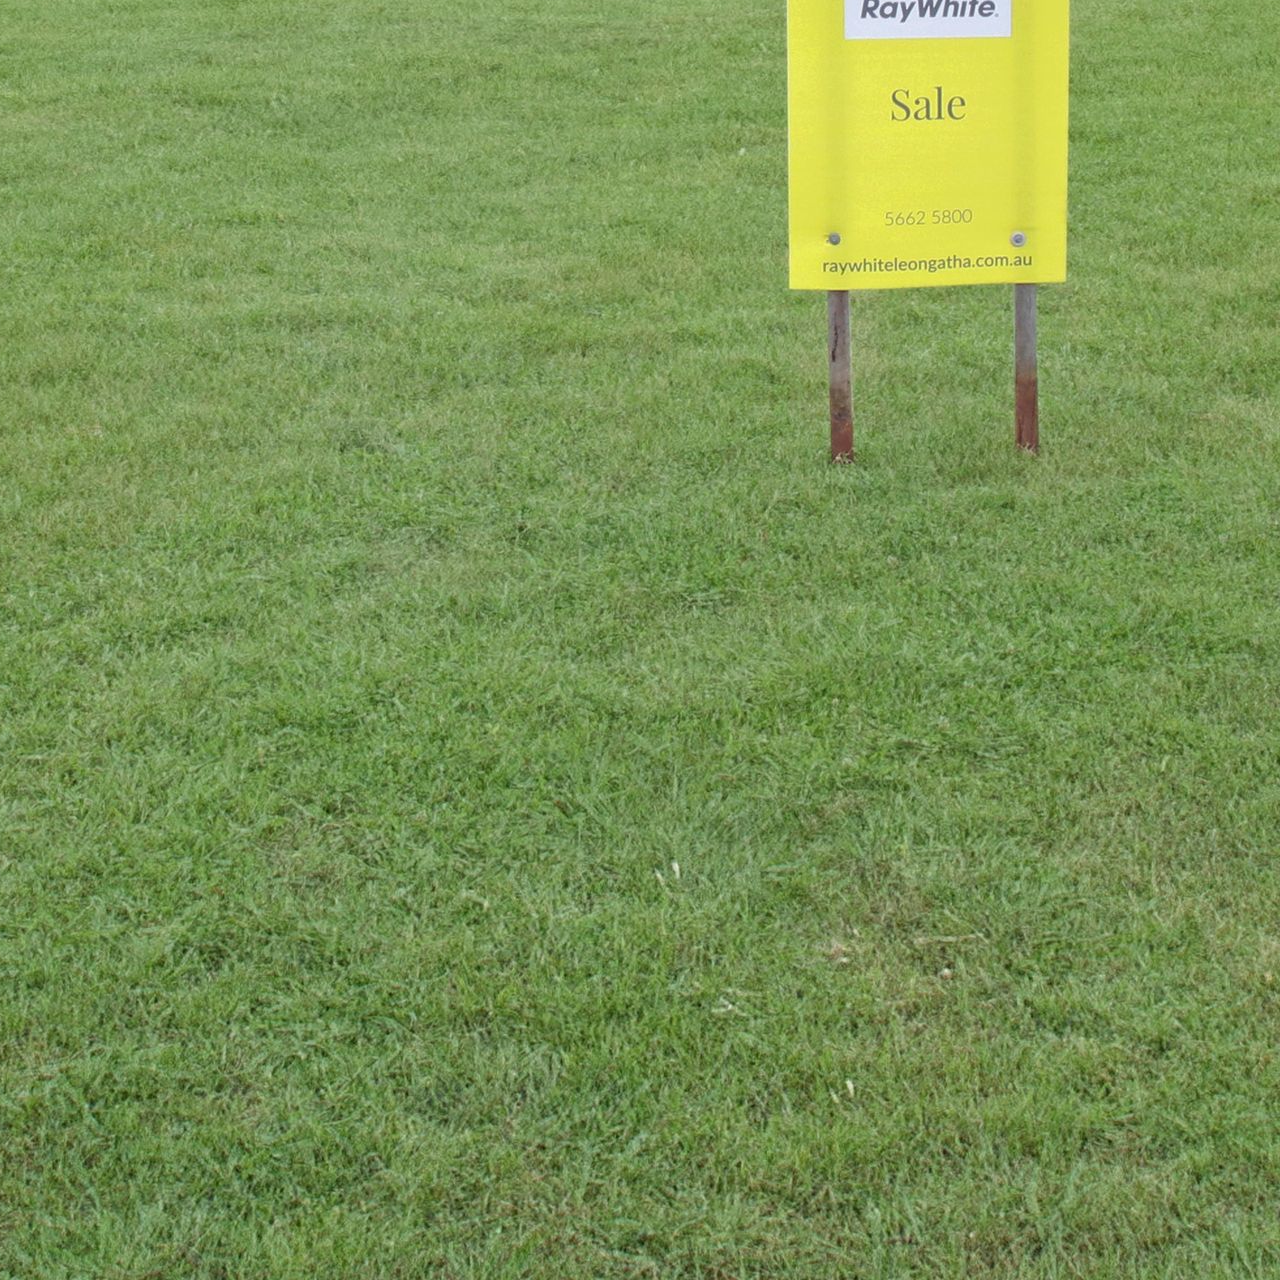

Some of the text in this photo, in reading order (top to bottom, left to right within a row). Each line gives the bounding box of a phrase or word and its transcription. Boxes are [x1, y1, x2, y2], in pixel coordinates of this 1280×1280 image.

[891, 86, 966, 122] Sale
[884, 209, 973, 226] 5662 5800
[822, 254, 1033, 276] raywhiteleongatha.com.au
